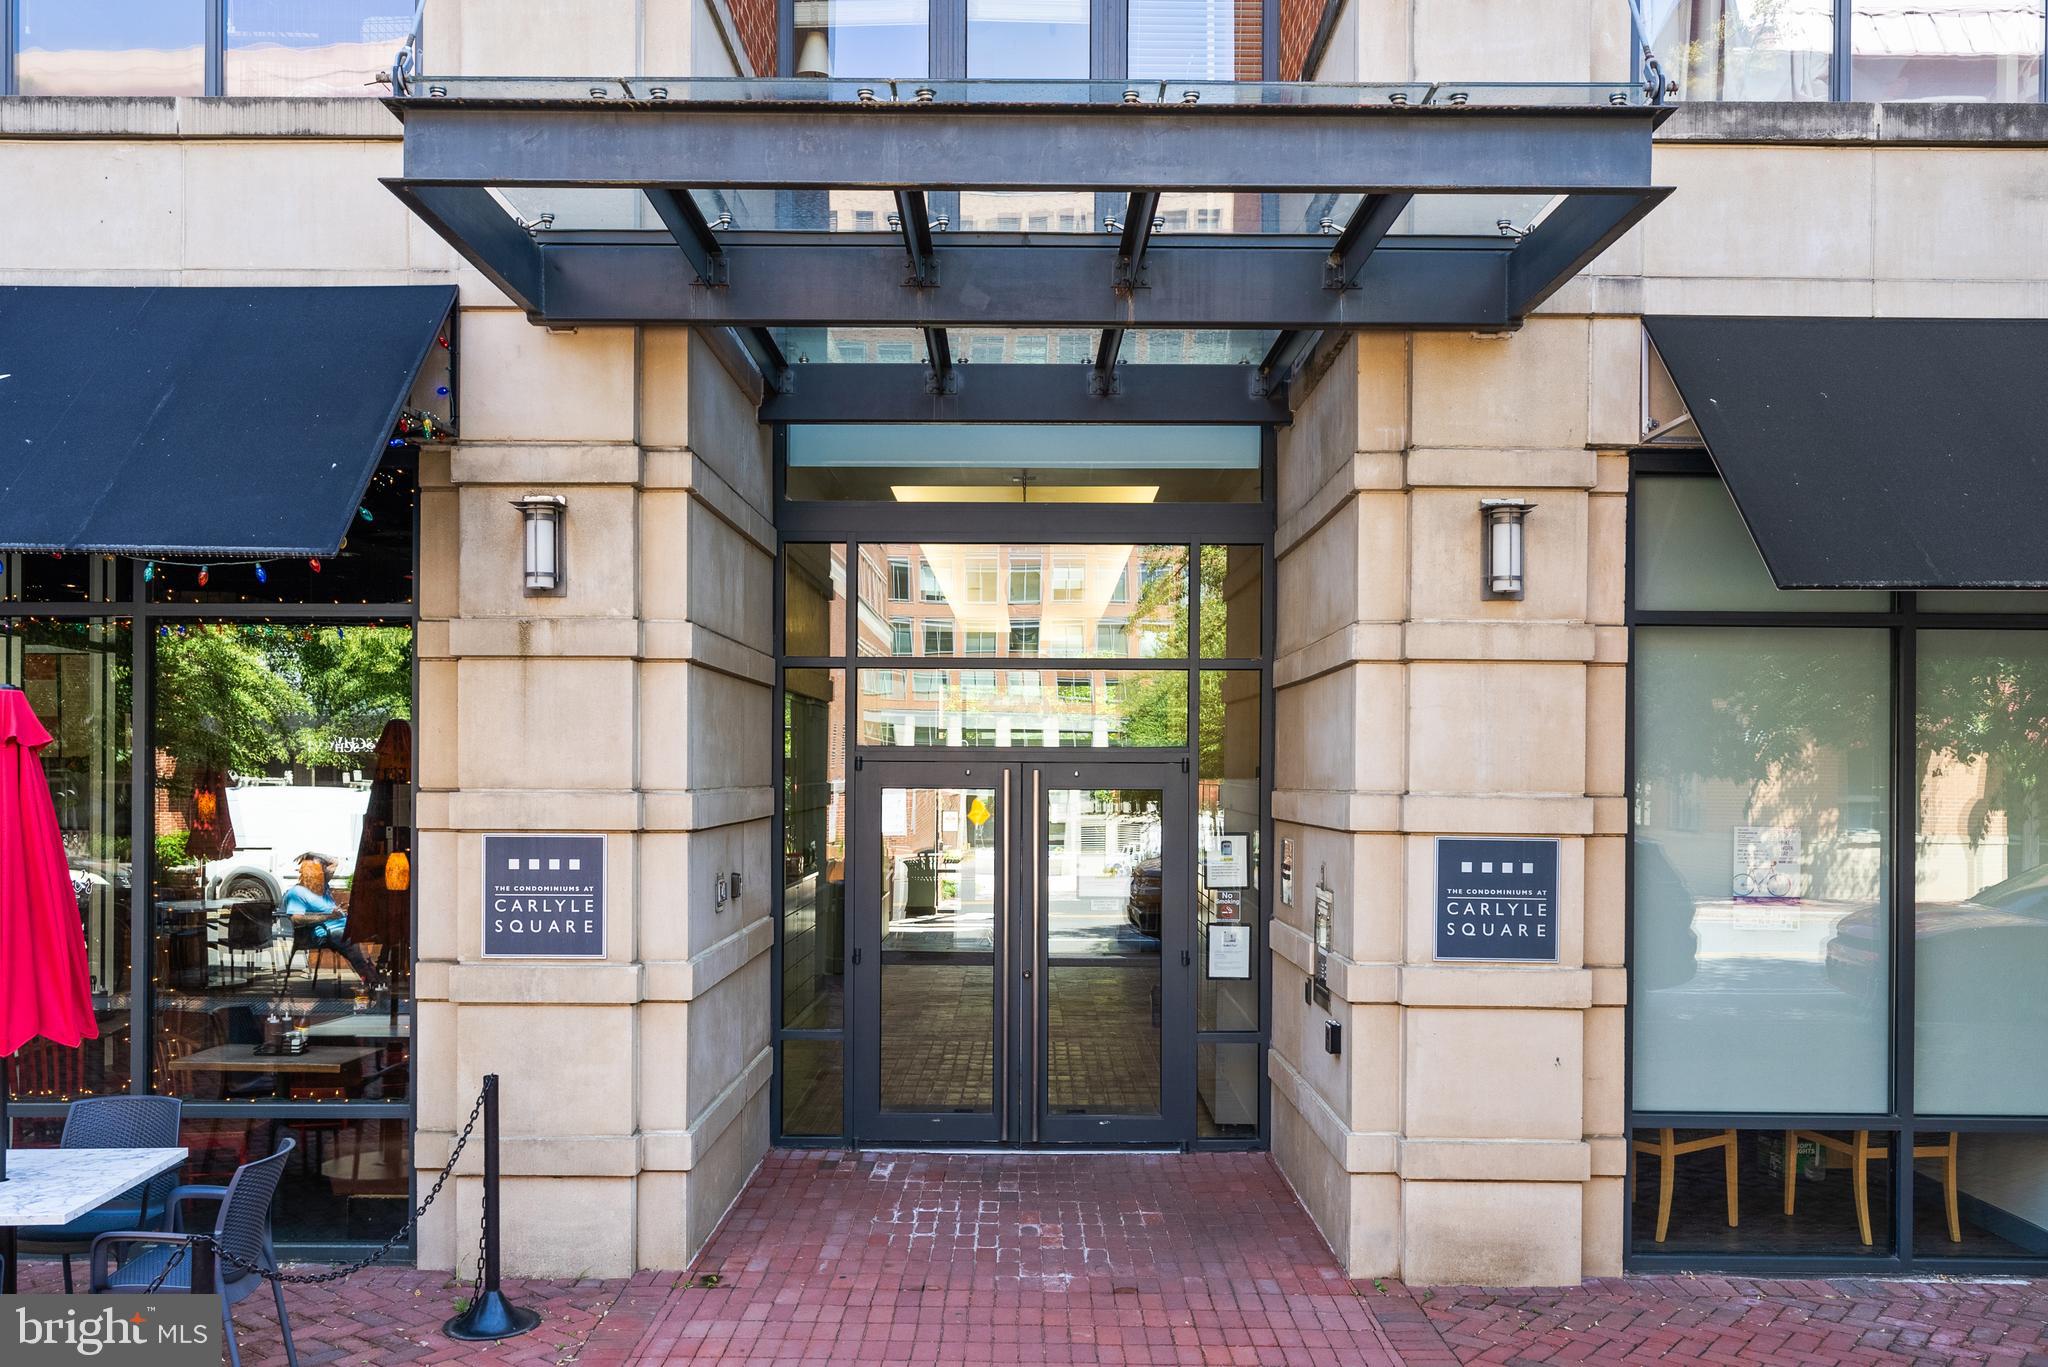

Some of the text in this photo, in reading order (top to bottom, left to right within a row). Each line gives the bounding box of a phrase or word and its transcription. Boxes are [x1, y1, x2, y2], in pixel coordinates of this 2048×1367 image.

[1222, 891, 1233, 899] No
[1466, 888, 1533, 896] CONDOMINIUMS
[494, 899, 594, 913] CARLYLE
[1447, 902, 1547, 917] CARLYLE
[495, 919, 593, 933] SQUARE
[1446, 922, 1546, 937] SQUARE
